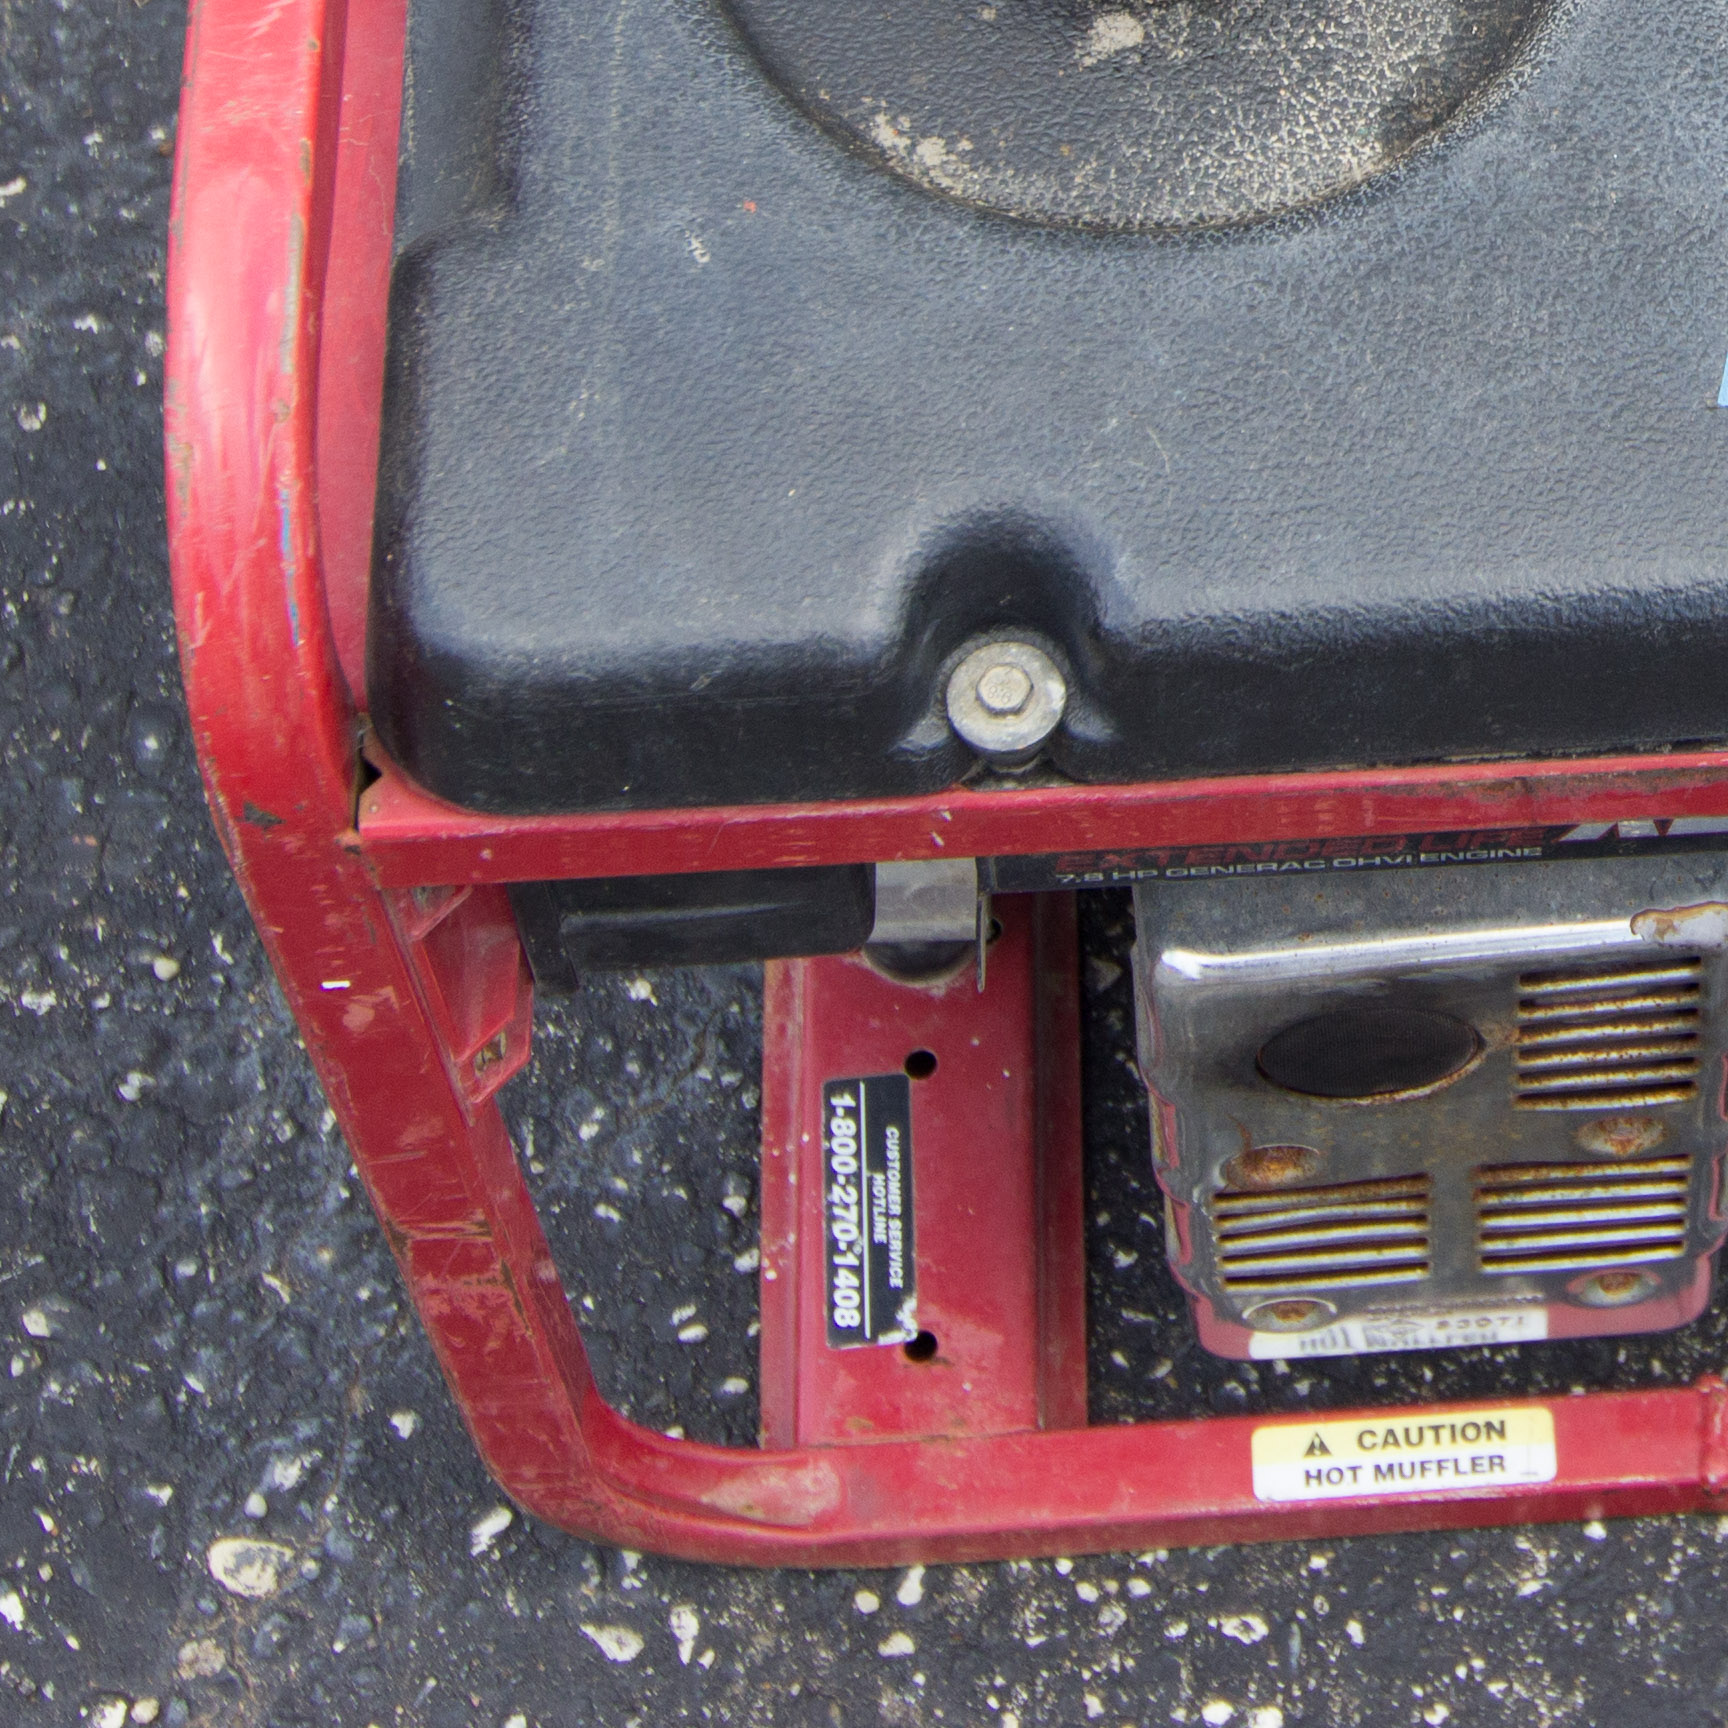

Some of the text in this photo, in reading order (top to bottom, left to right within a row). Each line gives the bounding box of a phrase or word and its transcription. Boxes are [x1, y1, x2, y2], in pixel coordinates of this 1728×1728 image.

[1056, 833, 1408, 872] EXTENDED
[1419, 826, 1547, 854] LIFE
[1112, 867, 1159, 881] HP
[1165, 859, 1327, 879] GENERAC
[1419, 846, 1543, 864] ENGINE
[830, 1092, 861, 1328] 1-800-270-1408
[871, 1172, 888, 1245] HOTLINE
[885, 1125, 904, 1290] CUSTOMER SERVICE
[1356, 1419, 1507, 1452] CAUTION
[1303, 1454, 1507, 1488] HOT MUFFLER
